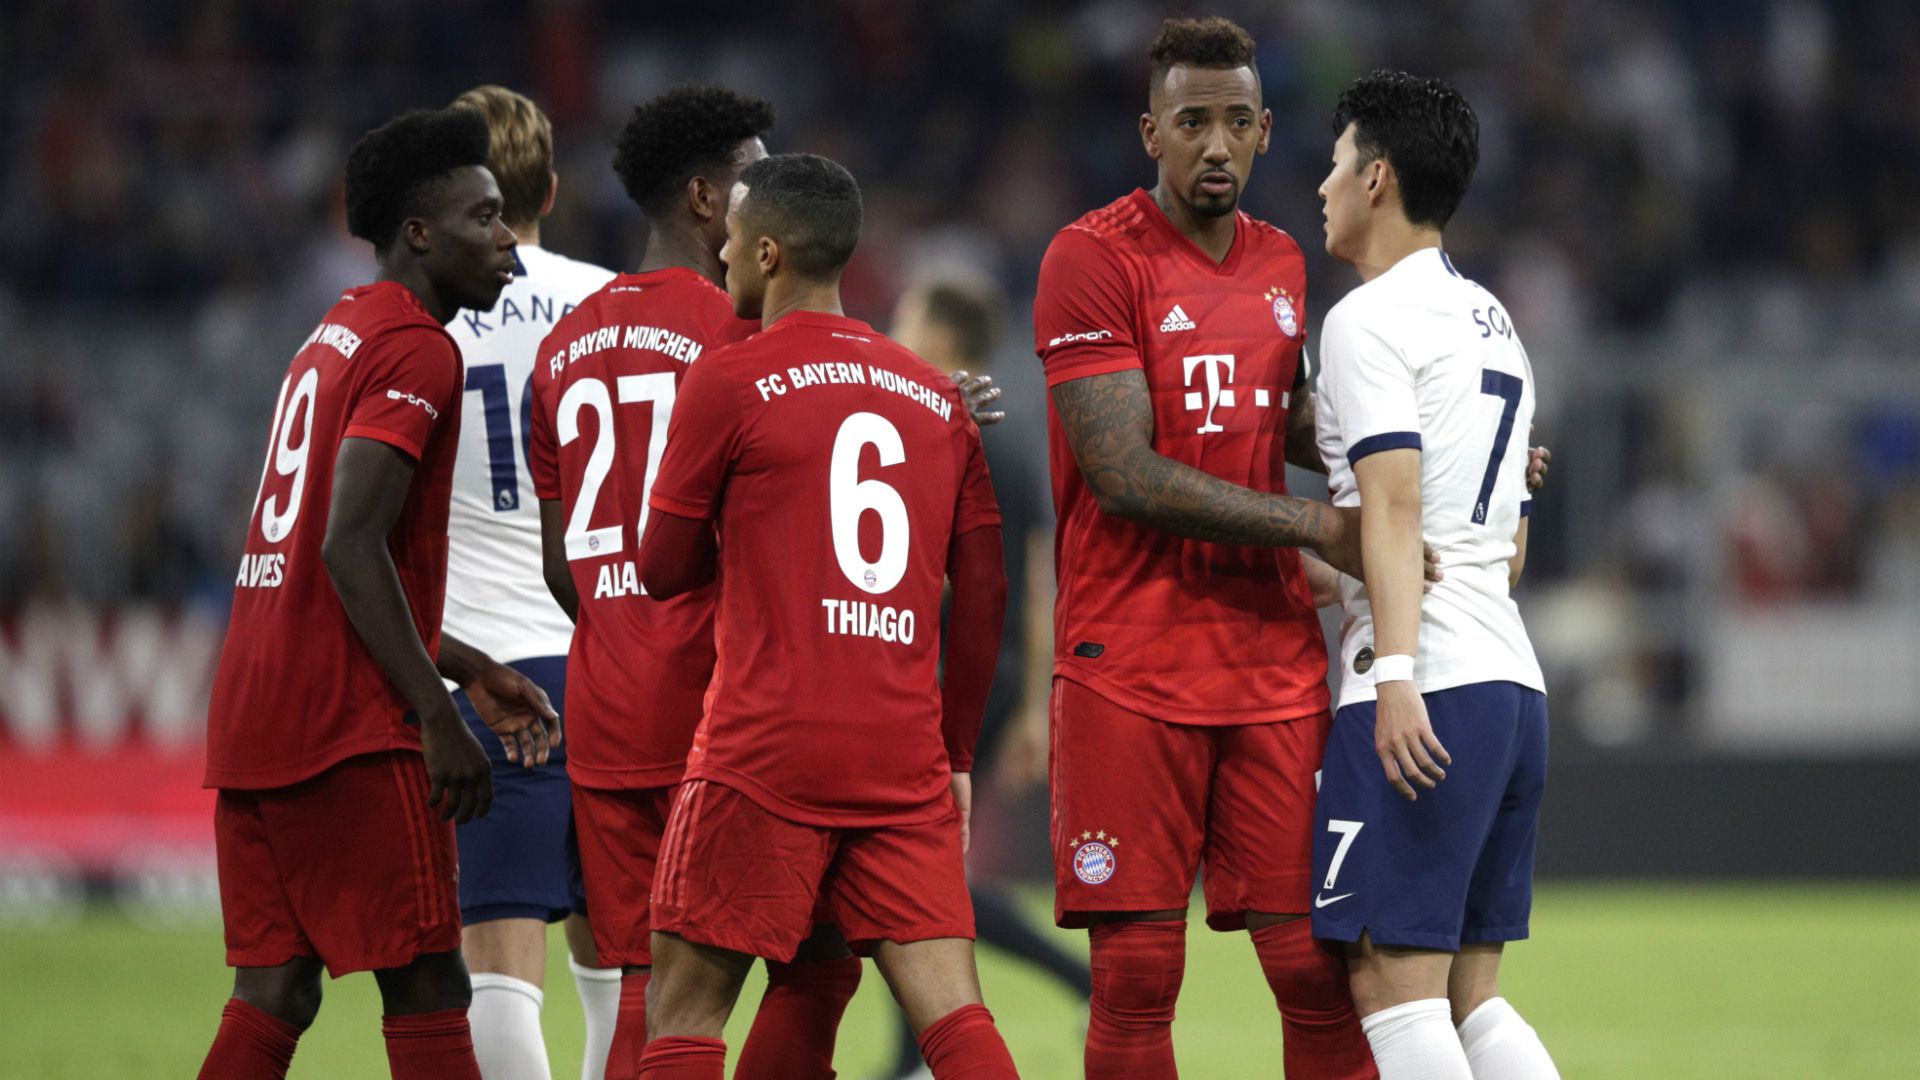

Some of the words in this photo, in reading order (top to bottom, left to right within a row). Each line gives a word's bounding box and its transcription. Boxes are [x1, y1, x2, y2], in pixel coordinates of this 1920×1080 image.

[1048, 329, 1113, 347] e-tron
[1160, 320, 1196, 333] adidas
[1471, 305, 1512, 340] SON
[550, 349, 566, 380] FC
[568, 324, 620, 364] BAYRN
[622, 324, 704, 364] MÜNCHEN
[386, 388, 439, 420] e-tron
[755, 373, 787, 402] FC
[786, 362, 866, 390] BAYERN
[868, 365, 952, 423] MÜNCHEN
[556, 371, 676, 562] 27
[1470, 367, 1524, 526] 7
[829, 411, 910, 595] 6
[594, 560, 649, 600] ALA
[821, 598, 915, 646] THIAGO
[1322, 818, 1365, 890] 7
